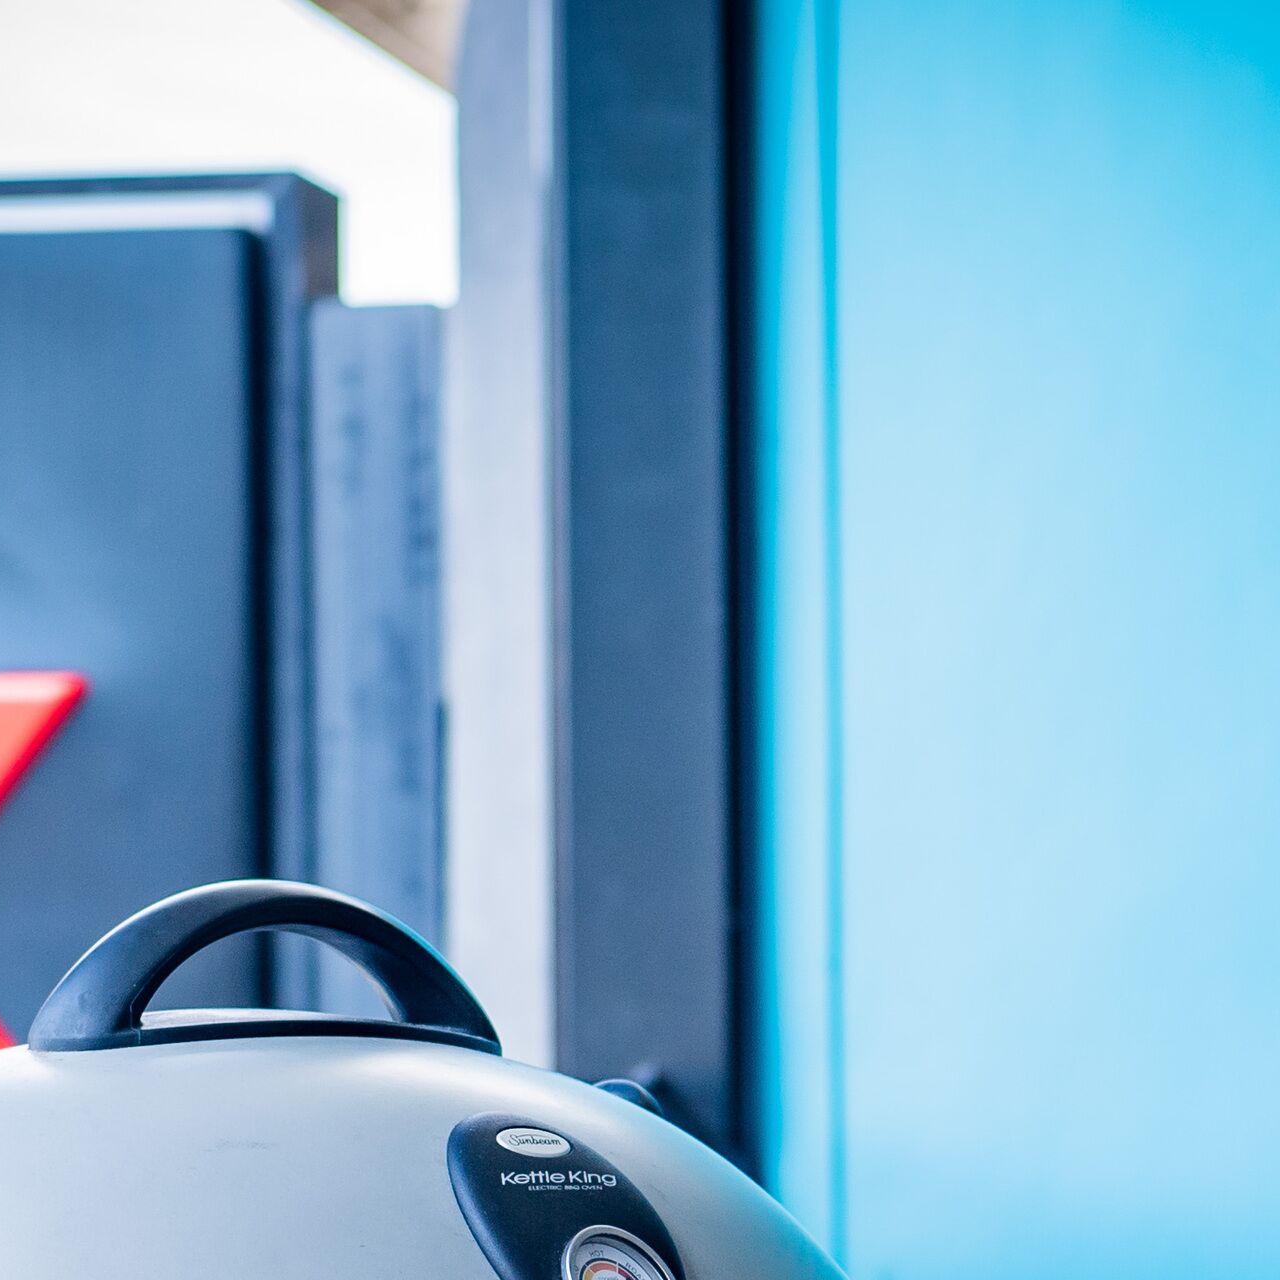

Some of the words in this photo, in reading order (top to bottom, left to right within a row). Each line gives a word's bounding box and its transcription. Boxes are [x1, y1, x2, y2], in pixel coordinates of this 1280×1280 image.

[509, 1134, 562, 1147] Sunbeam
[500, 1170, 566, 1186] Kettle
[568, 1170, 617, 1187] King
